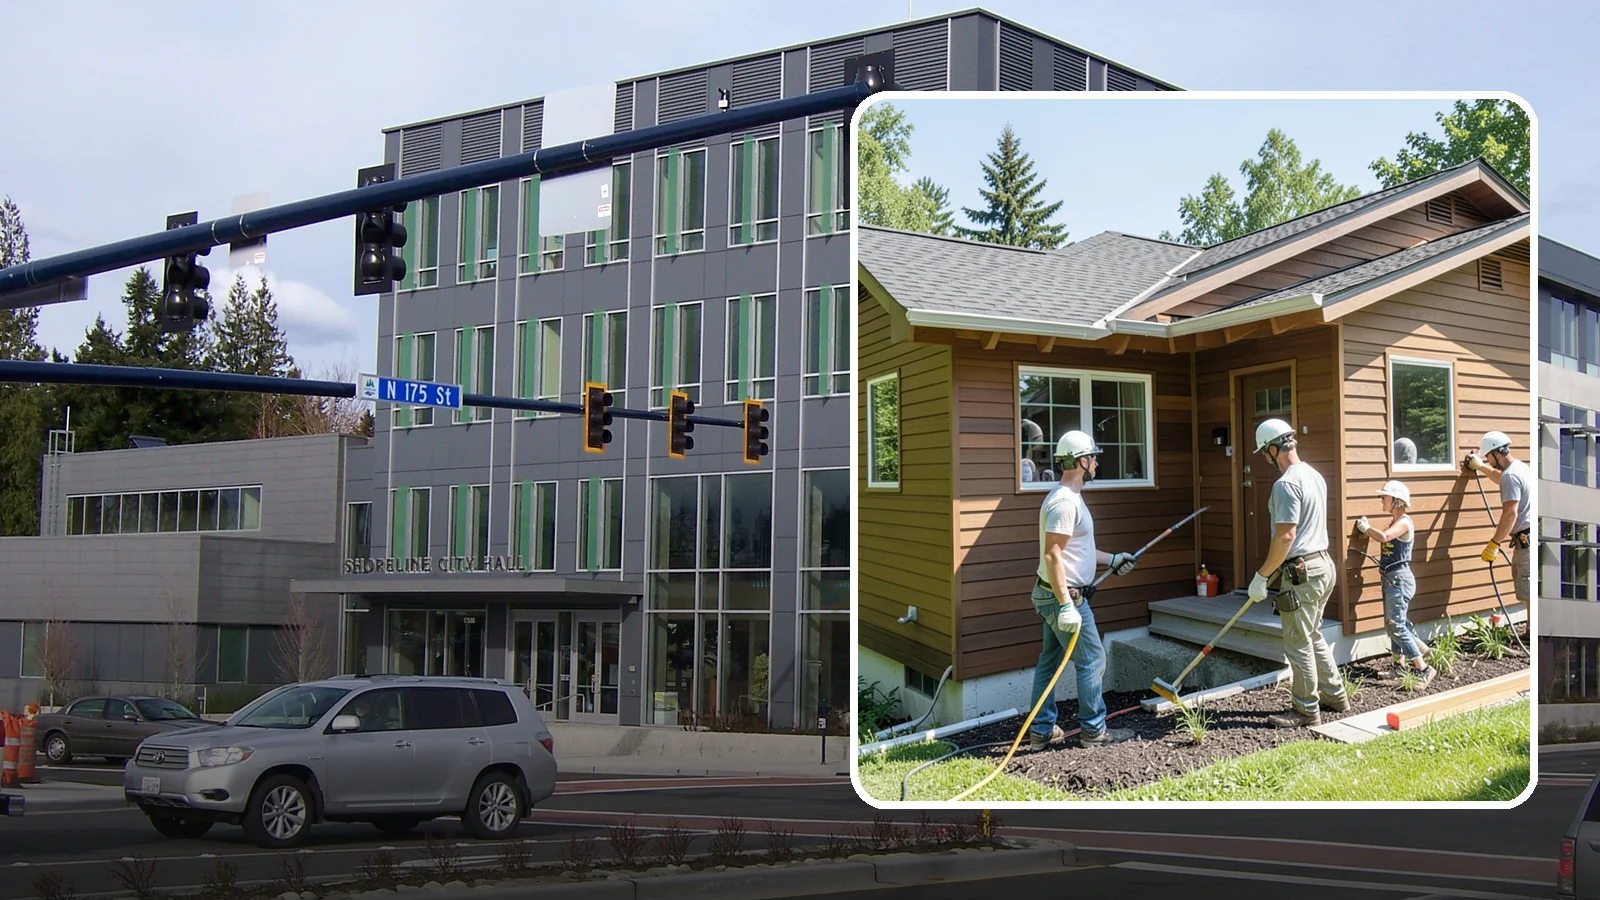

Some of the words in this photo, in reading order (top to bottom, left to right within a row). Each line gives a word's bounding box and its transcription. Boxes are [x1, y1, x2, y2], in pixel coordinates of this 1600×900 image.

[387, 380, 396, 400] N
[405, 382, 427, 403] 175
[436, 386, 451, 406] St
[344, 557, 432, 574] SHORELINE
[438, 556, 475, 572] CITY
[484, 556, 526, 572] HALL
